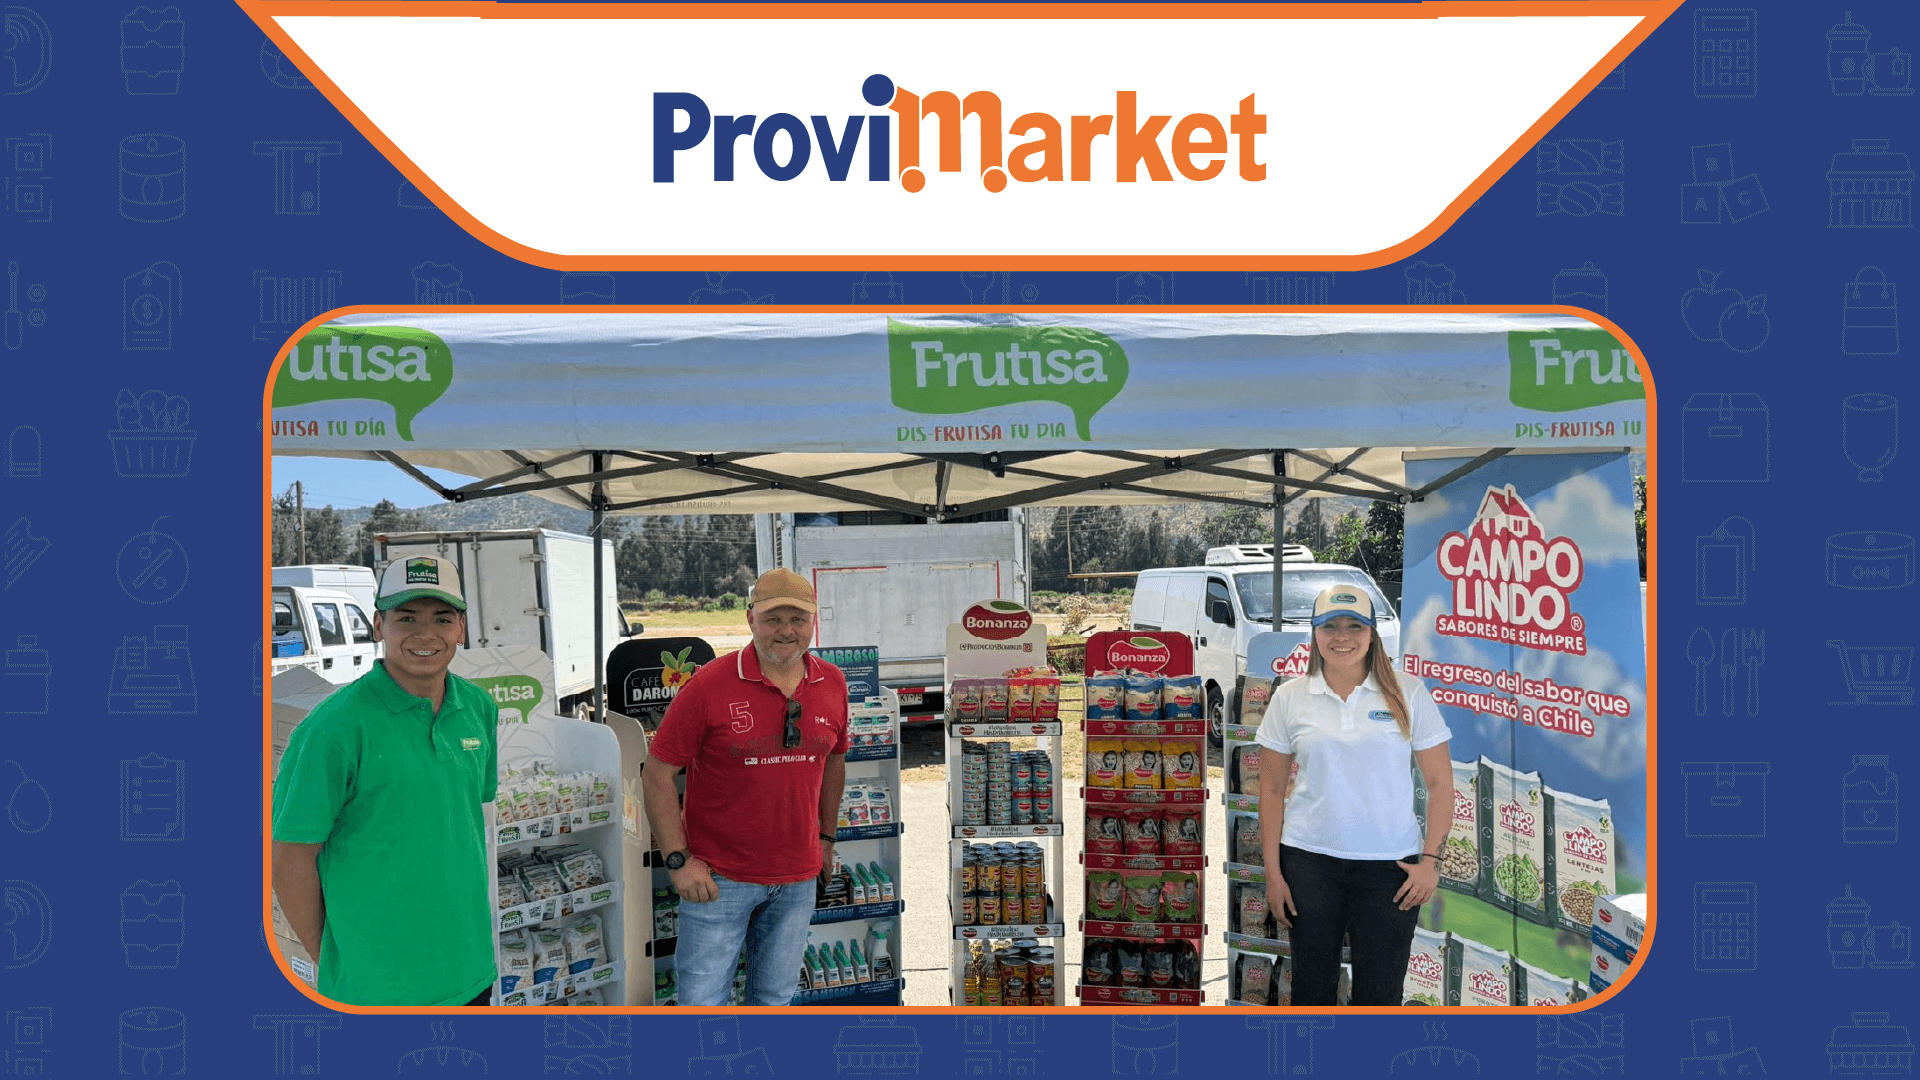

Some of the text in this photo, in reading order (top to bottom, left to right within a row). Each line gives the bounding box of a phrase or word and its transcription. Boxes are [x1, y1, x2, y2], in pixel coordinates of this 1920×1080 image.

[289, 336, 432, 382] utisa
[911, 341, 1109, 388] Frutisa
[1530, 339, 1644, 386] Frut
[272, 416, 386, 437] UTISA TU DÍA
[896, 424, 1002, 442] DIS-FRUTISA
[1010, 423, 1030, 440] TU
[1515, 420, 1642, 438] DIS-FRUTISA TU
[1441, 537, 1580, 588] CAMPO
[1457, 578, 1565, 630] LINDO
[966, 617, 1028, 629] Bonanza
[1438, 618, 1584, 651] SABORES DE SIEMPRE
[810, 648, 879, 665] OMBROSO!
[1111, 652, 1165, 663] Bonanza
[1272, 658, 1309, 674] CAM
[631, 674, 659, 687] CAFÉ
[1404, 656, 1628, 714] El regreso del sabor que
[488, 684, 535, 703] tisa
[632, 685, 680, 702] DAROM
[728, 701, 754, 734] 5
[1432, 690, 1593, 735] conquistó a Chile
[761, 756, 781, 765] CLASSIC
[1500, 804, 1534, 825] CAMPO
[1503, 813, 1530, 832] LINDO
[1452, 822, 1474, 832] ANZO
[1563, 831, 1607, 851] CAMPO
[1568, 841, 1602, 858] LINDO
[1566, 858, 1605, 874] LENTEJAS
